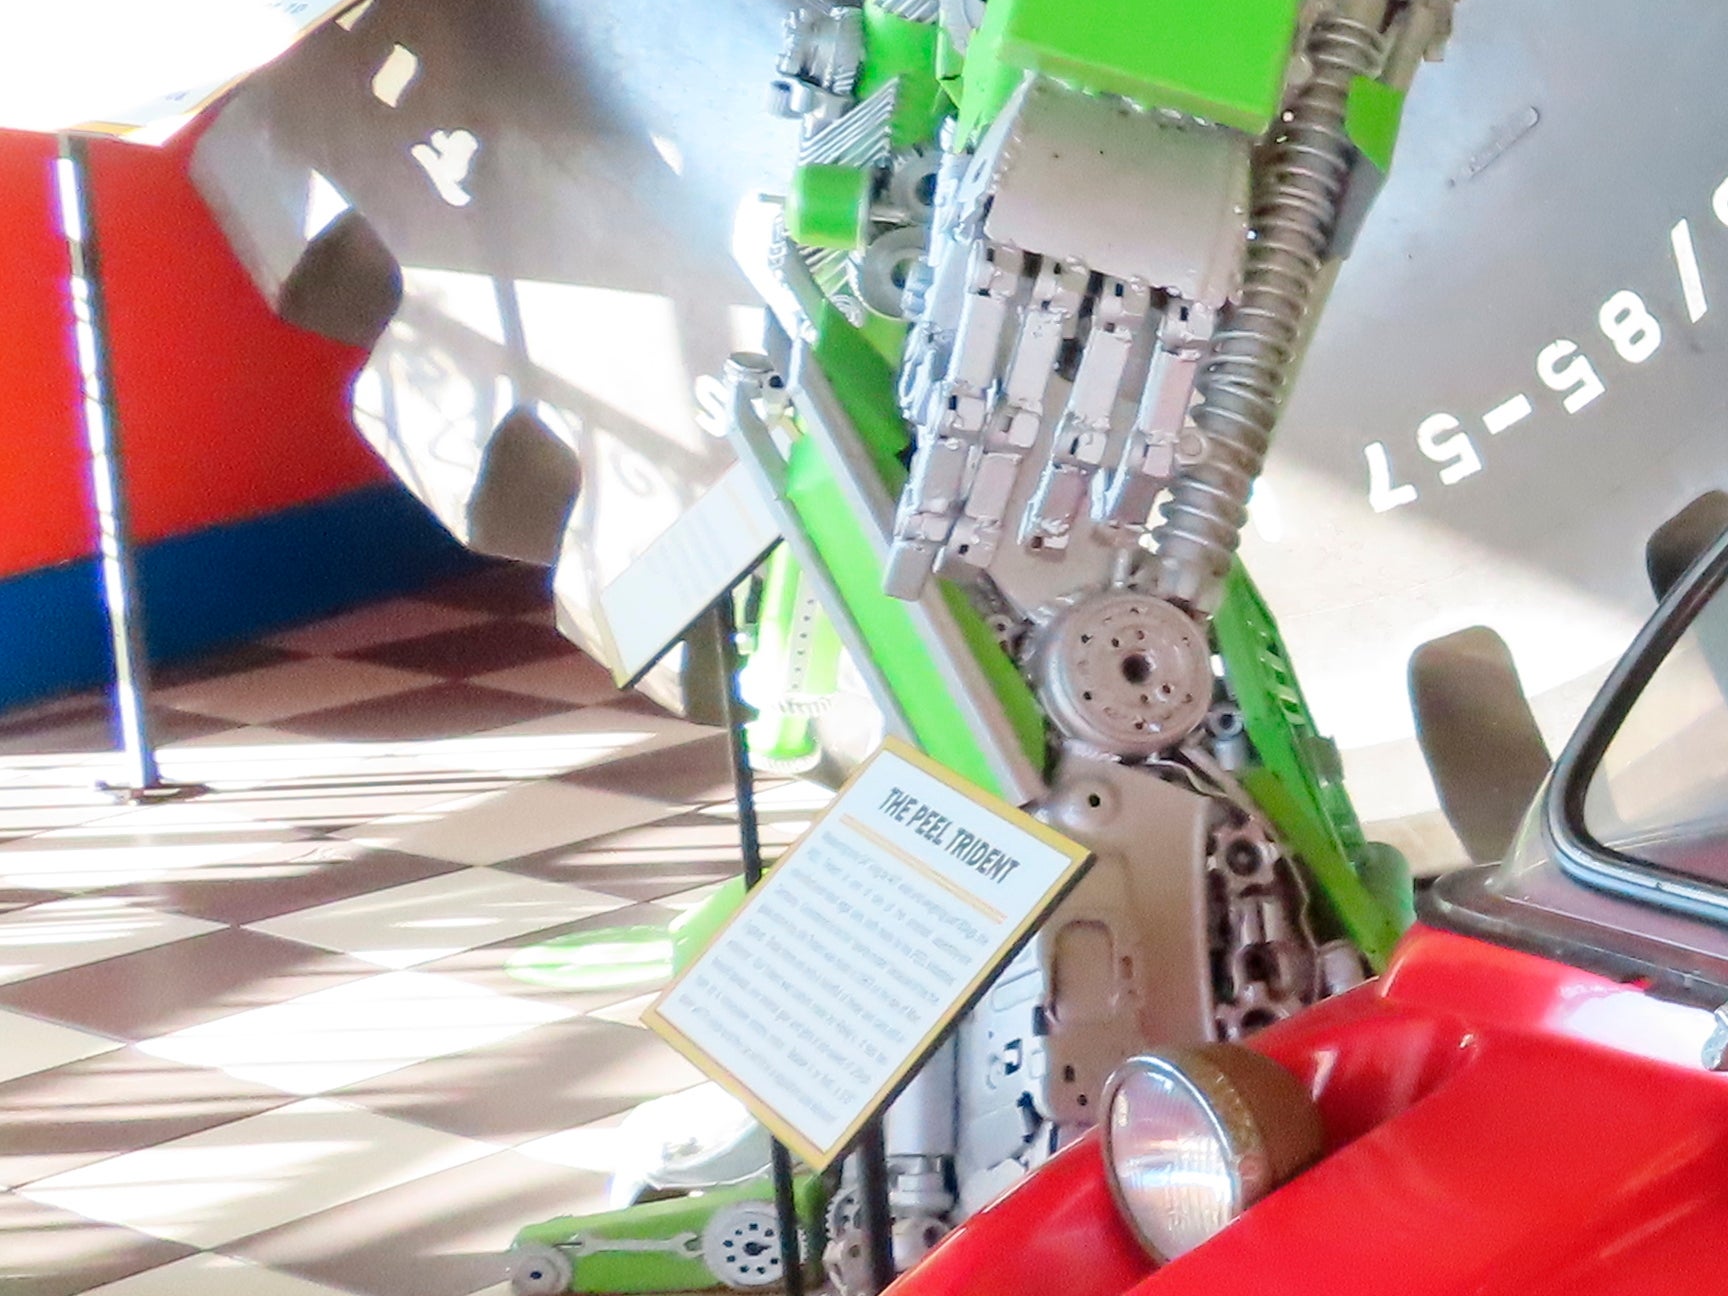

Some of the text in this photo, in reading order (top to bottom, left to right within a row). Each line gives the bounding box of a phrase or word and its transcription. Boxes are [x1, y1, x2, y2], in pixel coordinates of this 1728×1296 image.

[877, 787, 916, 821] THE
[906, 803, 950, 846] PEEL
[944, 827, 1020, 884] TRIDENT
